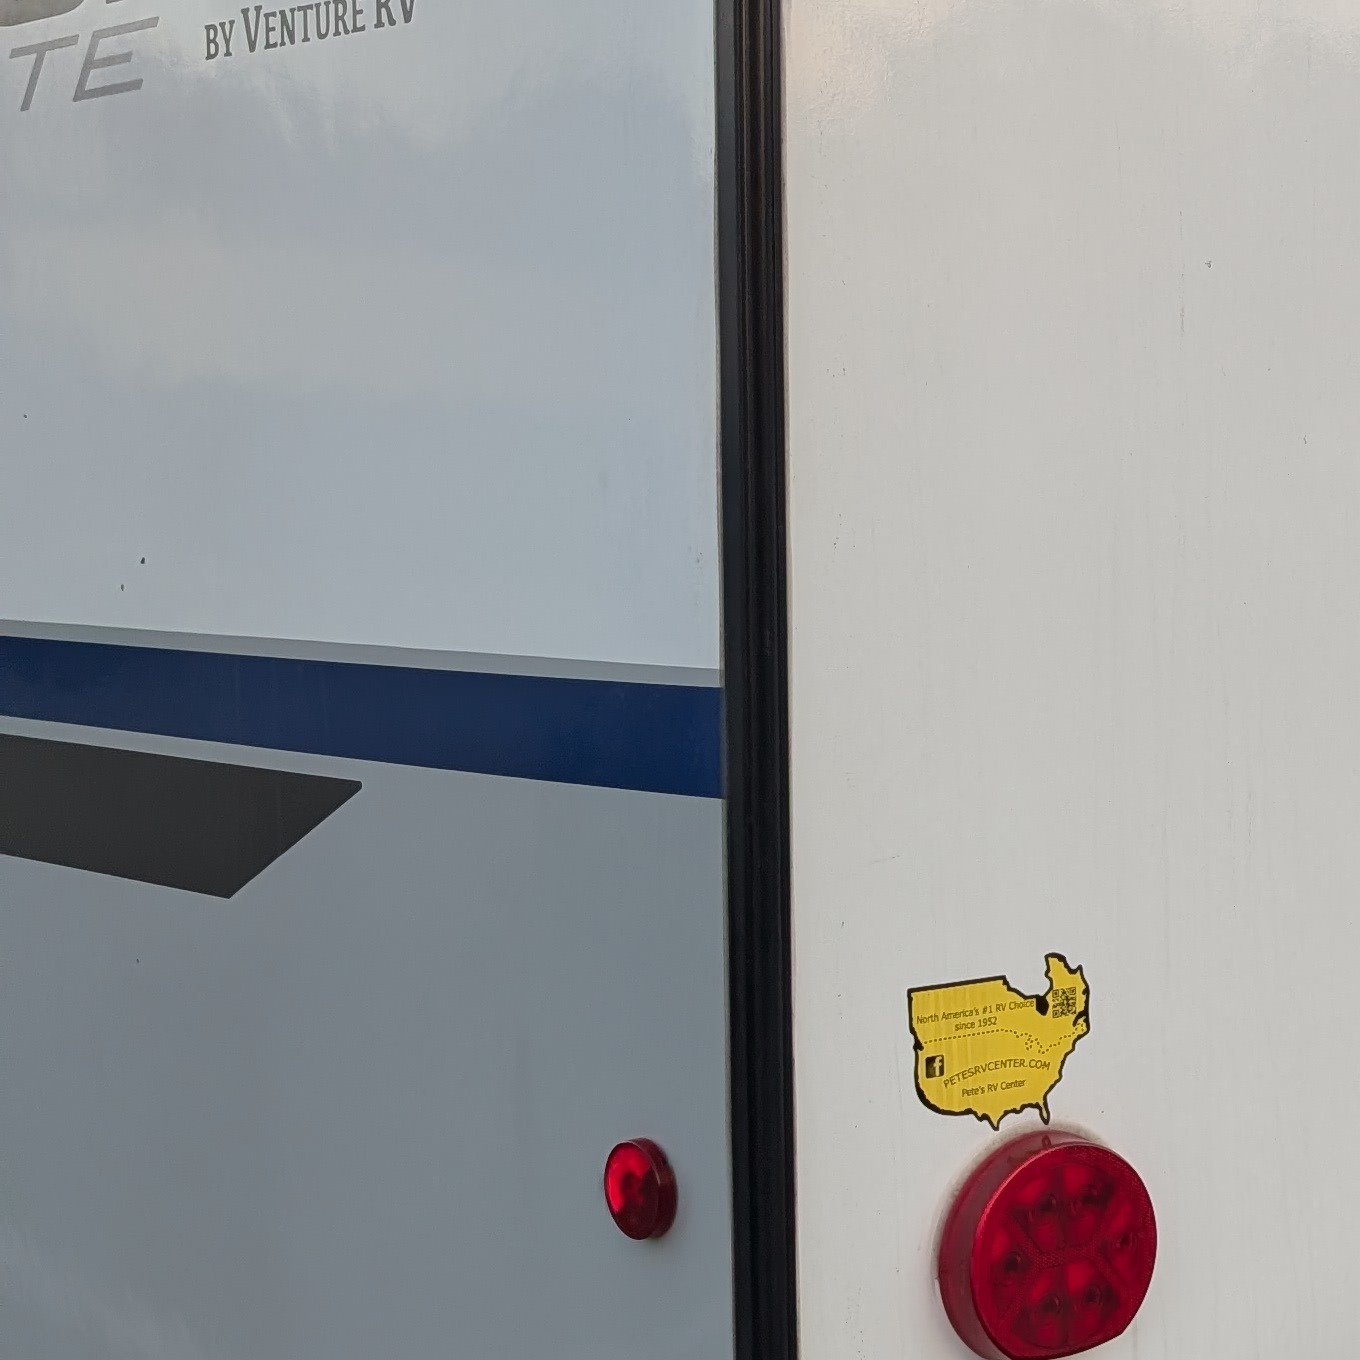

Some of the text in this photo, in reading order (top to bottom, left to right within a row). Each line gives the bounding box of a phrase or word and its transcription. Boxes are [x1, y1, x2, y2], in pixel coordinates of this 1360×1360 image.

[9, 16, 159, 112] TE
[916, 999, 1035, 1024] North America's #1 RV Choice
[954, 1016, 998, 1031] since 1952
[943, 1059, 1051, 1088] PETESRVCENTER.COM
[962, 1079, 1026, 1097] Pete's RV Center
